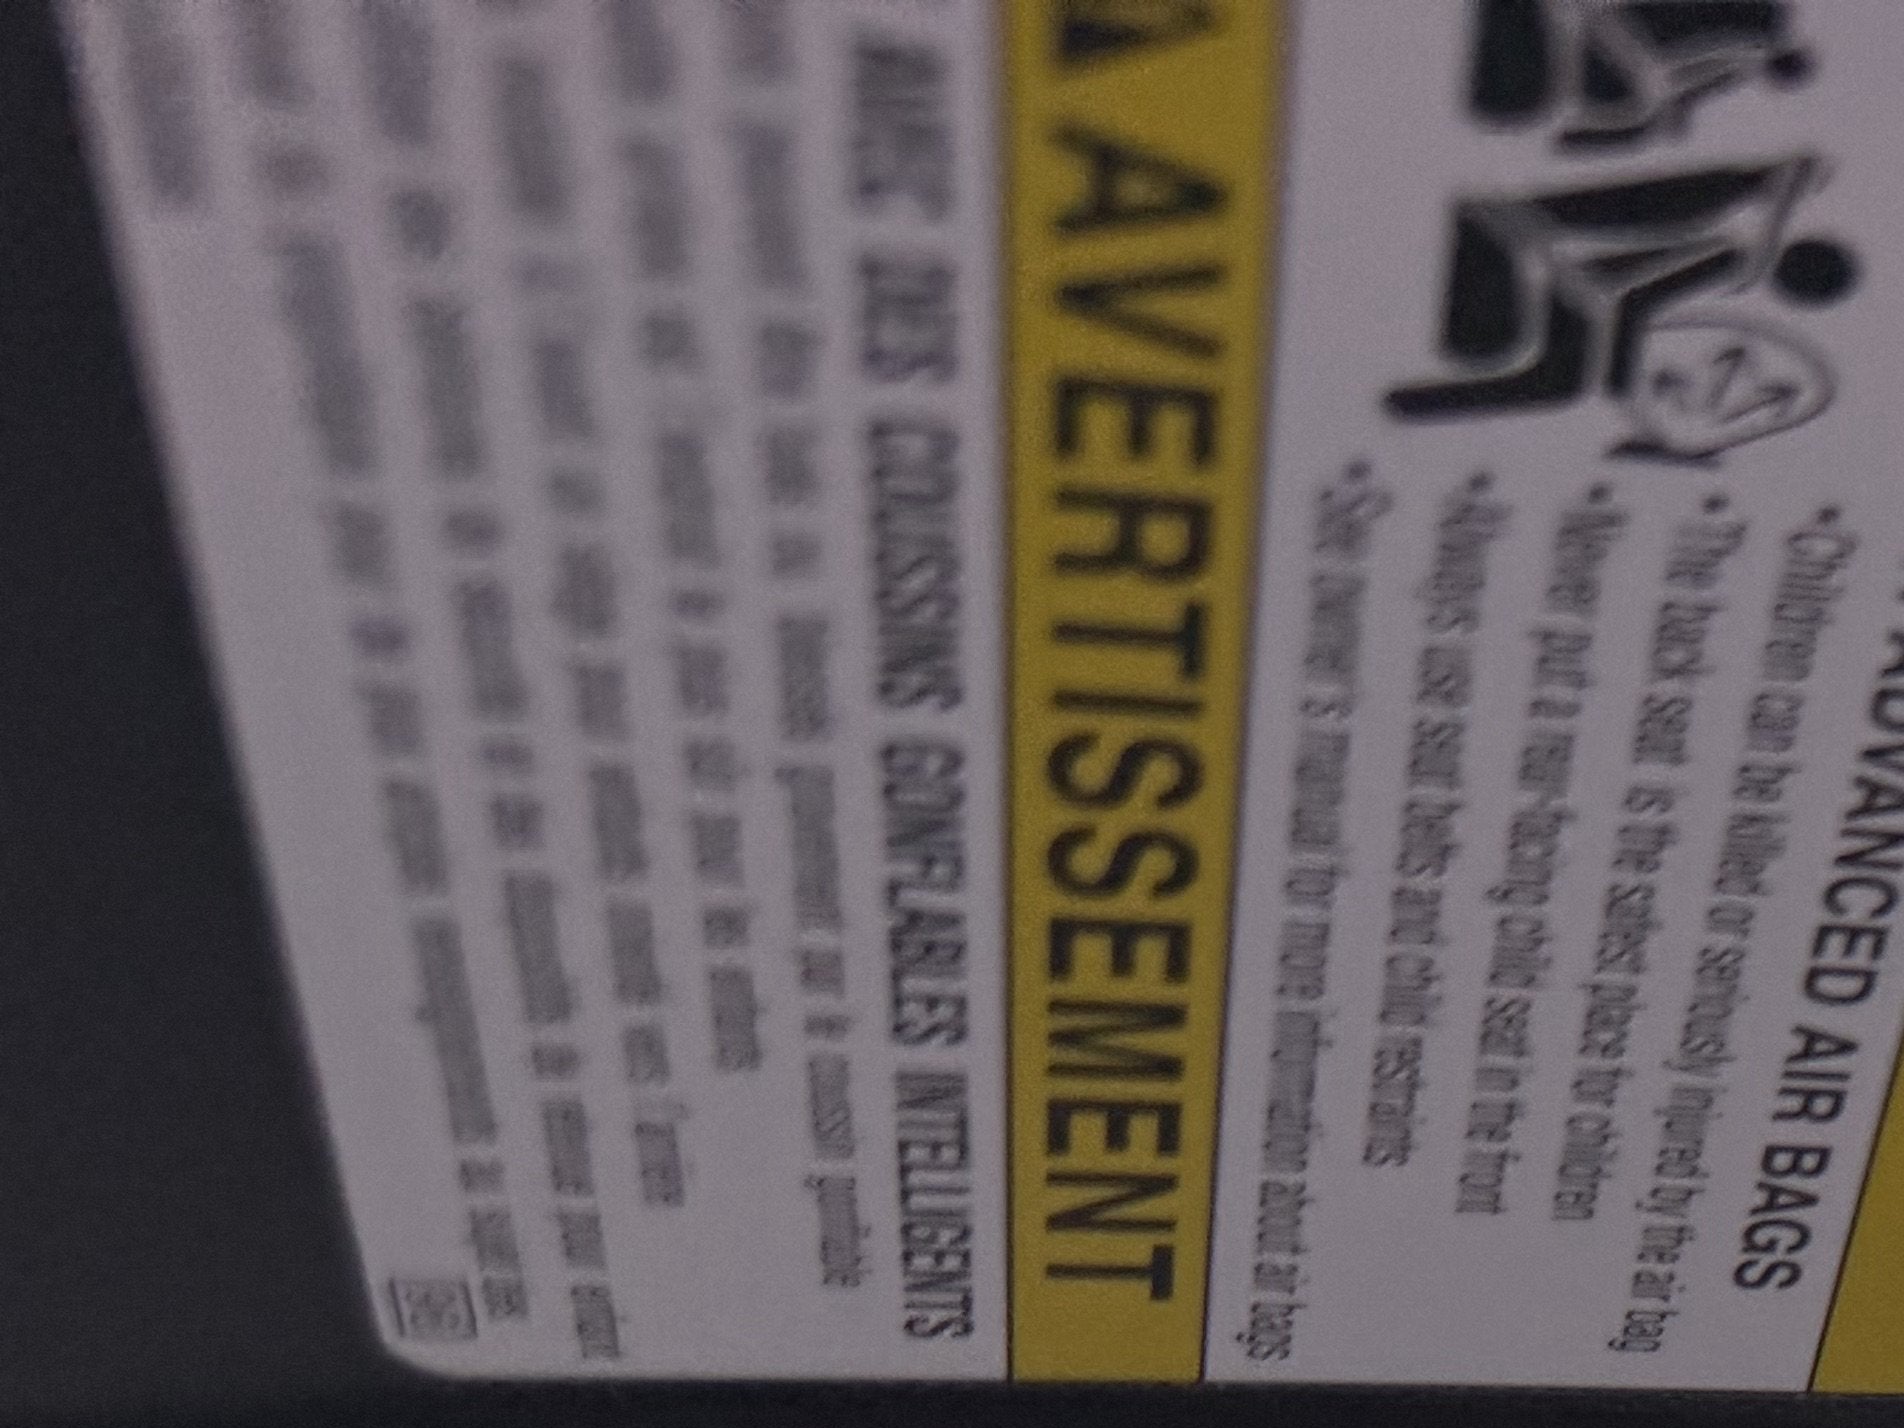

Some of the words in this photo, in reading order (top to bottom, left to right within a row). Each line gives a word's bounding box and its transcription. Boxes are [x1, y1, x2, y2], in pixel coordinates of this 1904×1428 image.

[1665, 523, 1748, 588] The
[1044, 131, 1230, 1302] AVERTISSEMENT
[1745, 693, 1804, 752] can
[1732, 763, 1802, 803] be
[1613, 822, 1678, 873] the
[879, 741, 969, 1045] GONFLABLES
[1706, 905, 1757, 939] or
[1485, 913, 1551, 989] child
[1478, 997, 1532, 1058] seat
[1577, 982, 1646, 1059] place
[1661, 947, 1747, 1079] seriously
[1474, 1067, 1529, 1093] in
[1569, 1067, 1632, 1107] for
[1769, 1025, 1859, 1123] AIR
[1463, 1100, 1527, 1142] the
[1652, 1085, 1726, 1180] injured
[1453, 1149, 1521, 1215] front
[1551, 1112, 1617, 1220] children
[892, 1072, 975, 1339] INTELLIGENTS
[1635, 1187, 1704, 1218] by
[1733, 1145, 1831, 1290] BAGS
[1637, 1226, 1695, 1265] the
[1252, 1262, 1308, 1295] air
[1630, 1271, 1685, 1302] air
[1235, 1303, 1307, 1360] bags
[1607, 1310, 1680, 1352] bag
